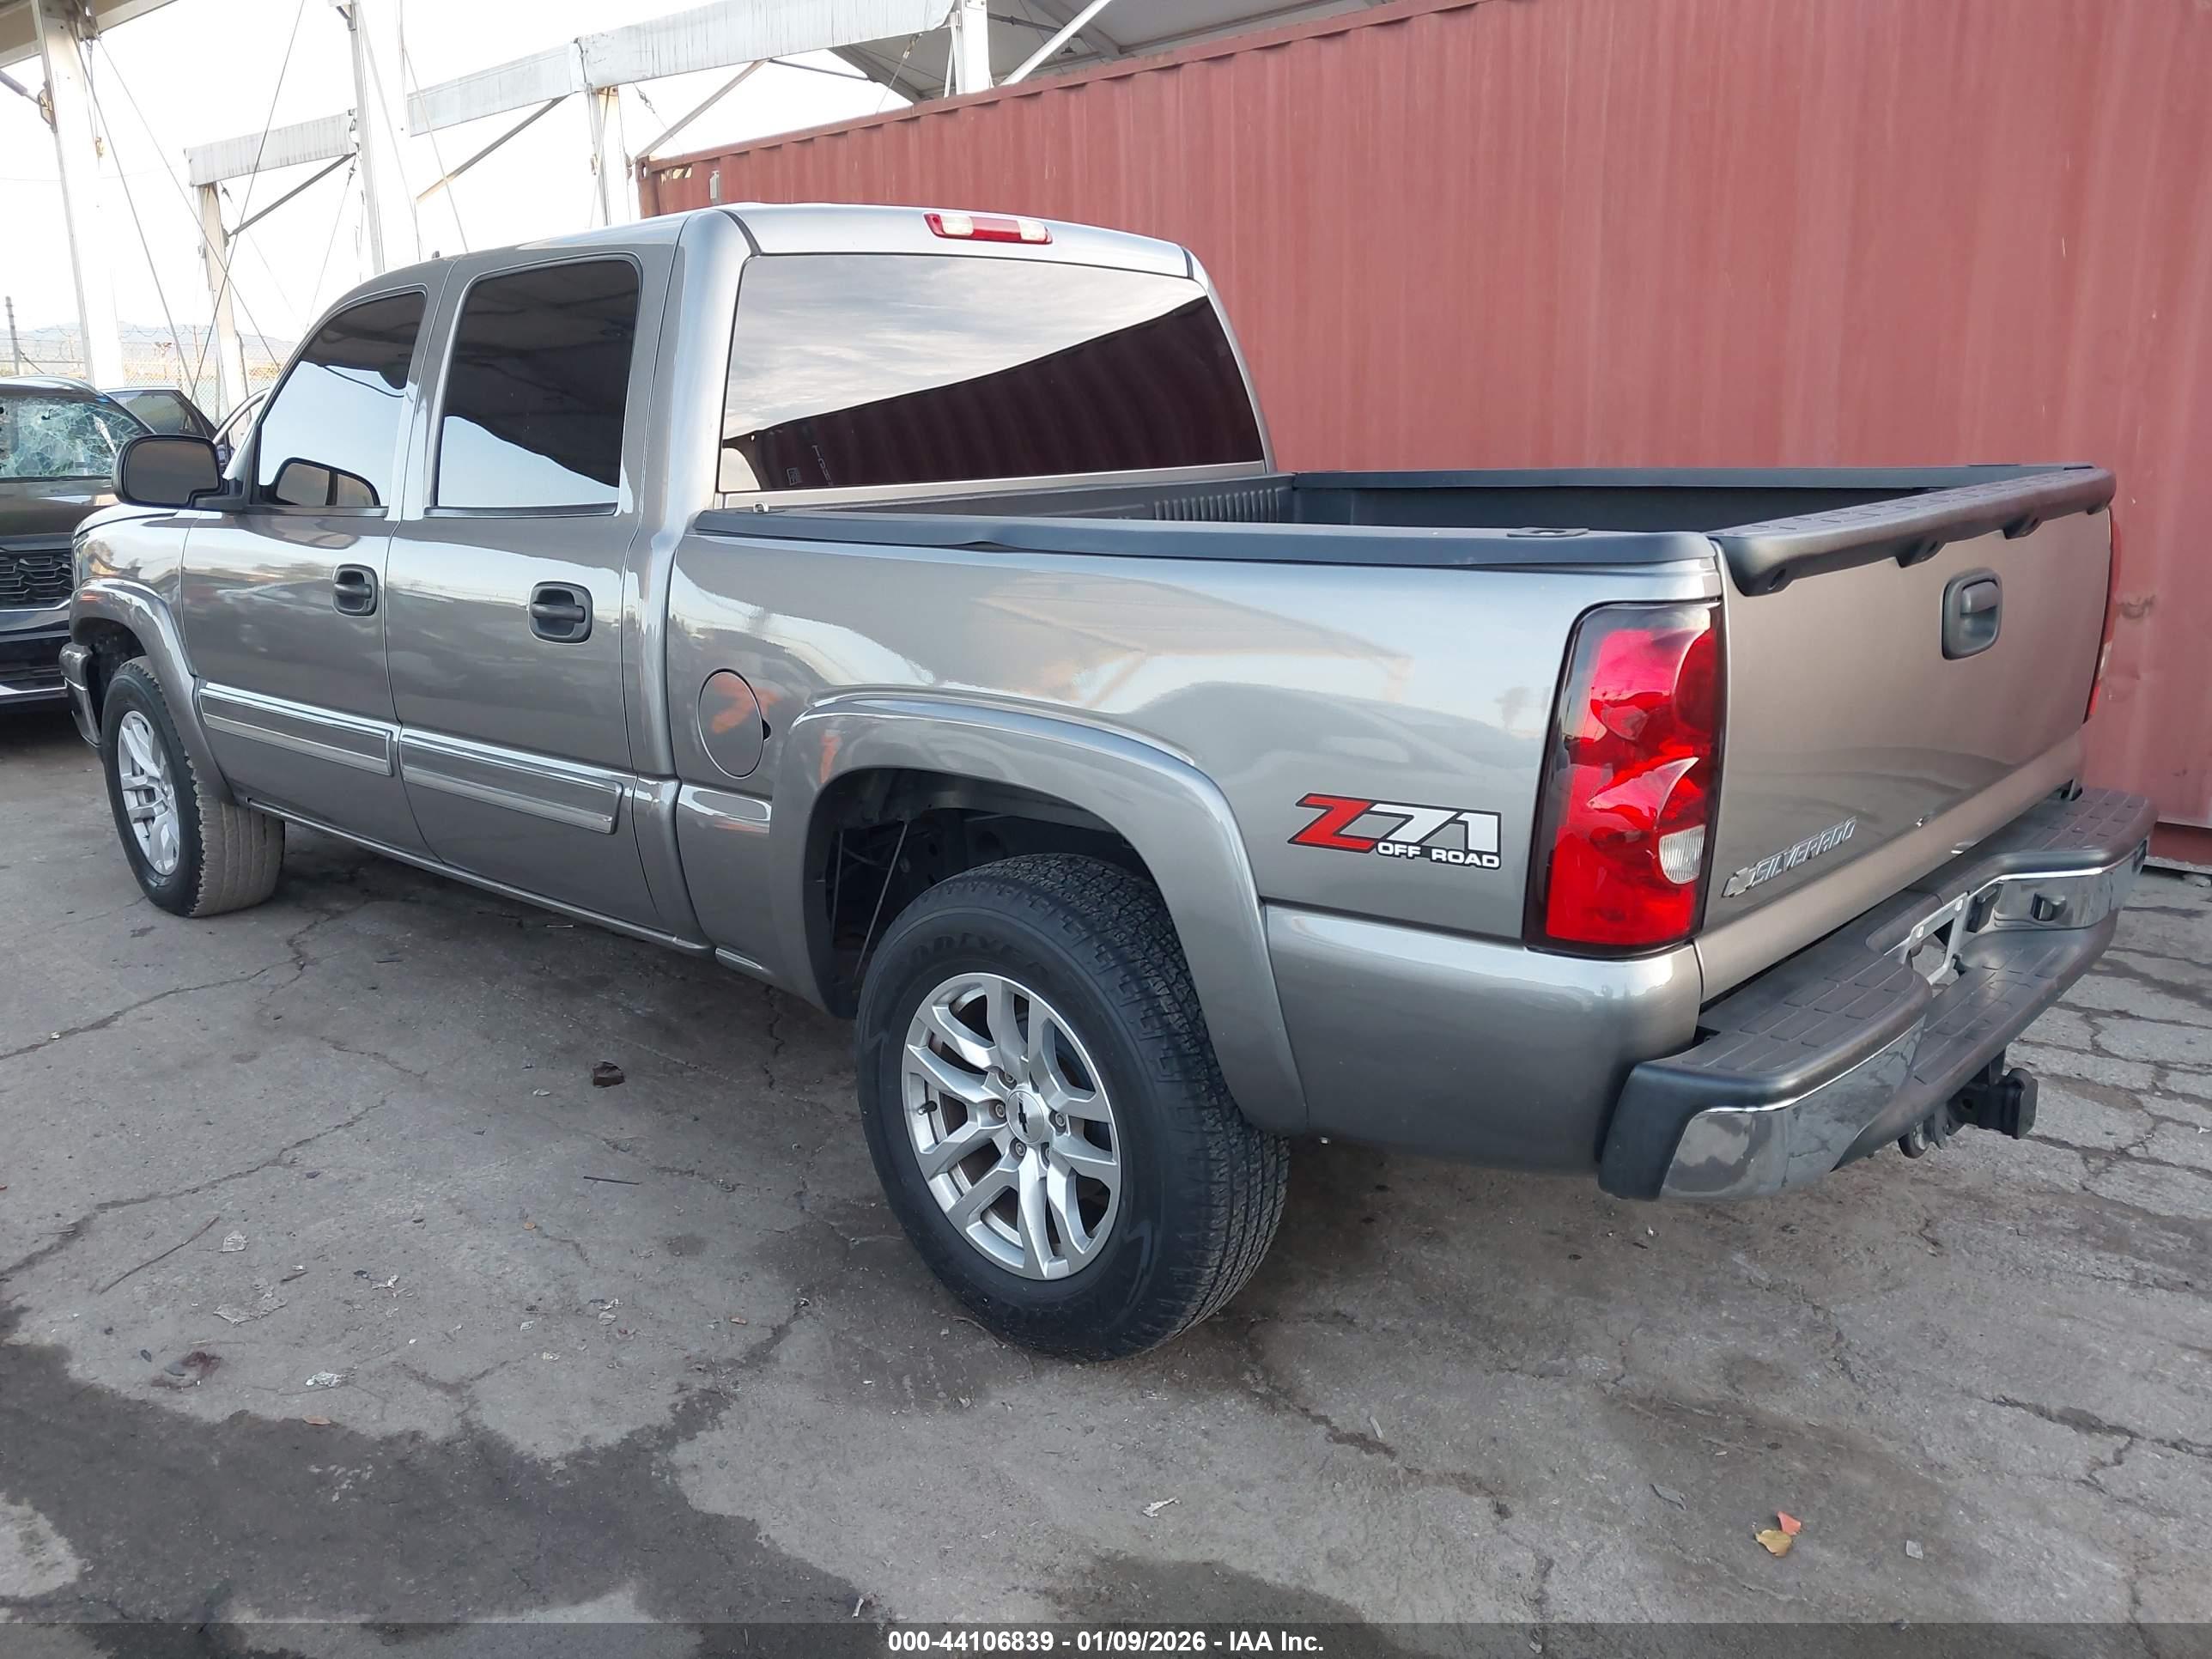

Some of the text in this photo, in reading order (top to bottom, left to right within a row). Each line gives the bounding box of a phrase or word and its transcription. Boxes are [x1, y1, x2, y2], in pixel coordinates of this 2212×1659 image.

[1287, 792, 1501, 853] Z71
[1752, 817, 1856, 886] SILVERADO
[1376, 842, 1500, 869] OFF ROAD
